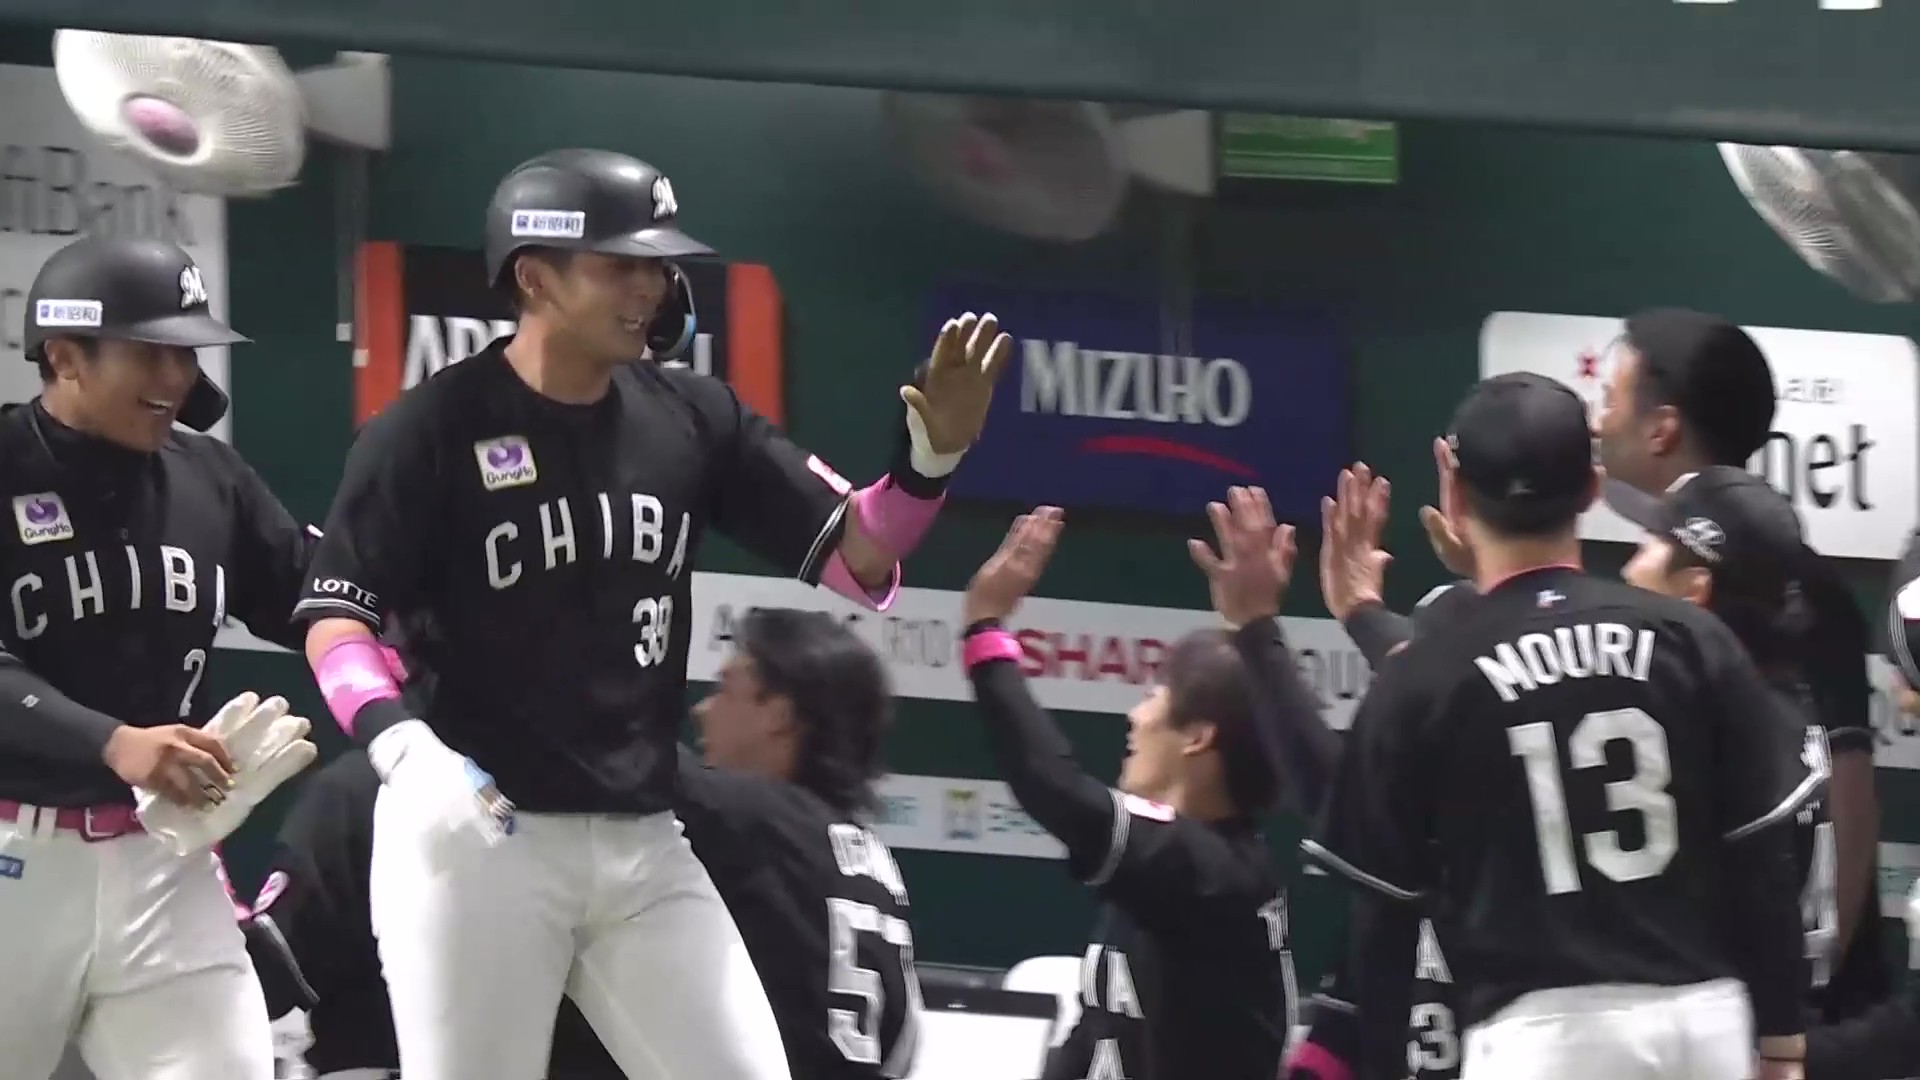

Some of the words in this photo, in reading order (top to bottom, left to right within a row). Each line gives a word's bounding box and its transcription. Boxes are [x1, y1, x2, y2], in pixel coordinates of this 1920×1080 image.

[1020, 338, 1252, 427] MIZUHO
[486, 466, 534, 484] GungHo
[24, 524, 72, 540] GungHo
[485, 491, 691, 590] CHIBA
[313, 577, 379, 608] LOTTE
[178, 648, 206, 717] 2
[1015, 628, 1173, 686] SHAR
[1473, 622, 1656, 702] MOURI
[1506, 707, 1680, 895] 13
